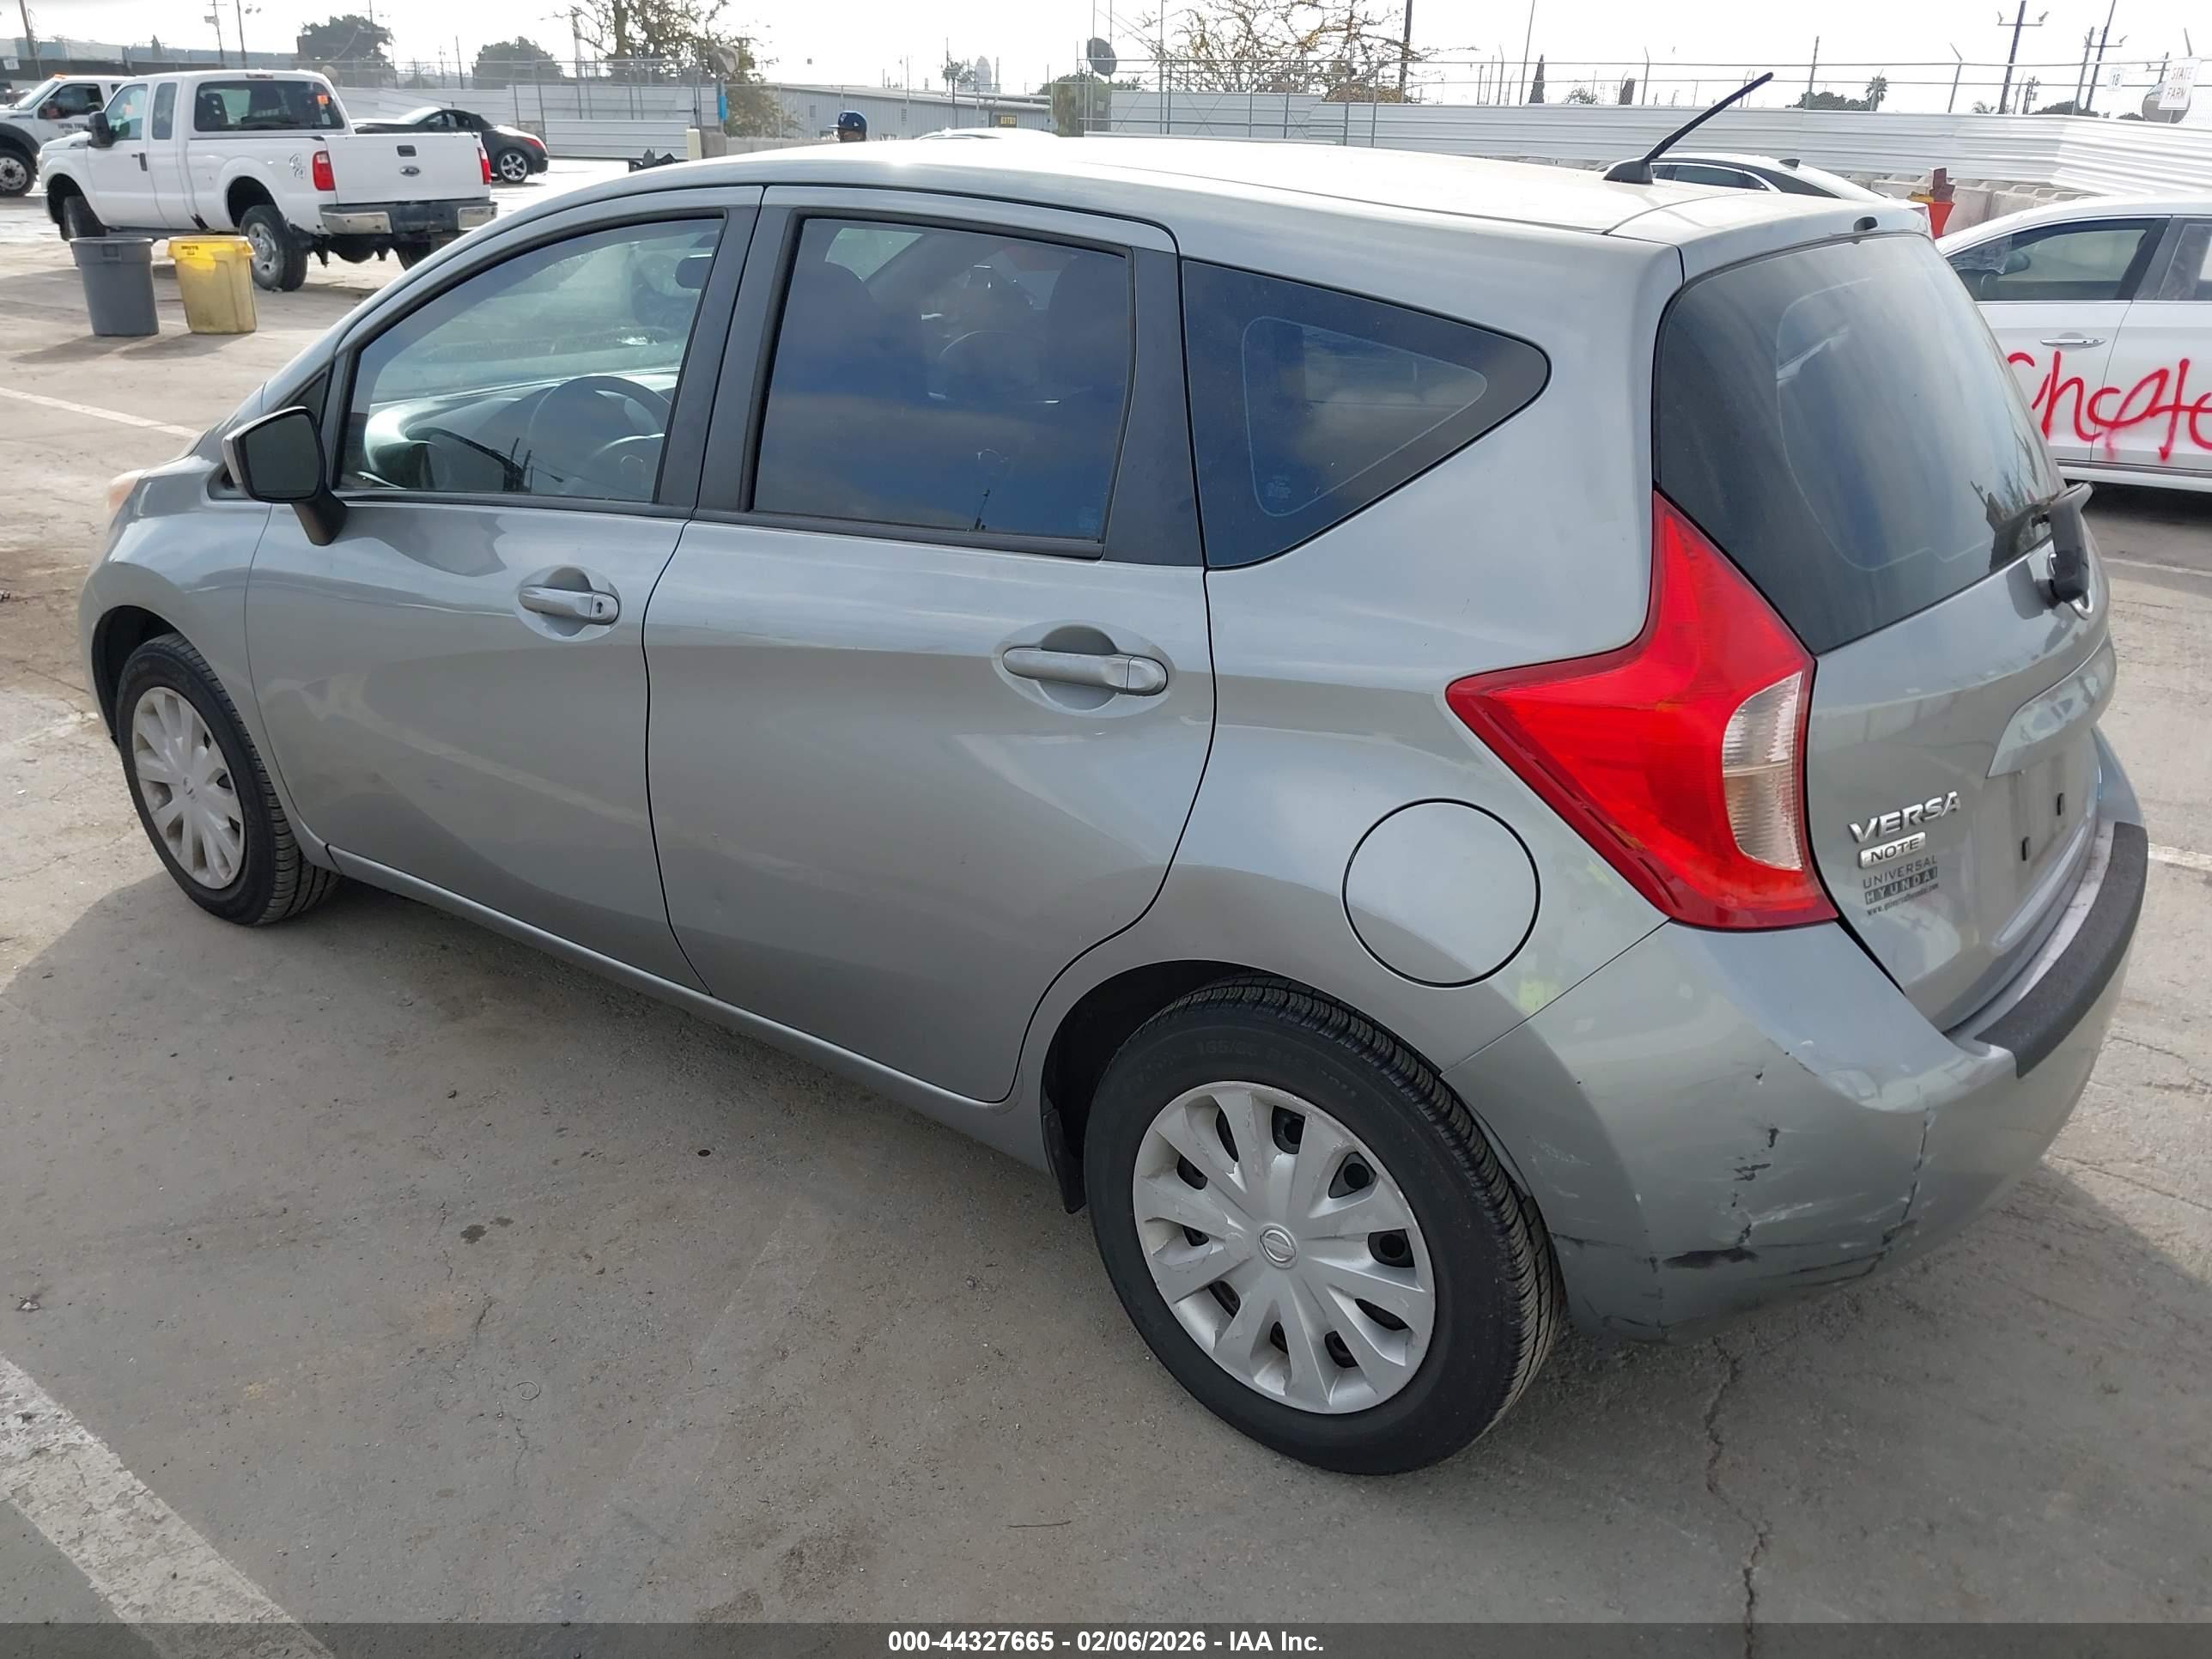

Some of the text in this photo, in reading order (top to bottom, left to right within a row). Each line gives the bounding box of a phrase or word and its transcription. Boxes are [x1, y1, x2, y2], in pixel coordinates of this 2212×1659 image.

[2112, 73, 2121, 87] 18
[2171, 66, 2194, 80] STATE
[2166, 87, 2186, 100] FARM
[1848, 790, 1962, 843] VERSA
[1870, 837, 1920, 863] NOTE
[1863, 855, 1938, 889] UNIVERSAL
[1865, 867, 1938, 905] HYUNDAI
